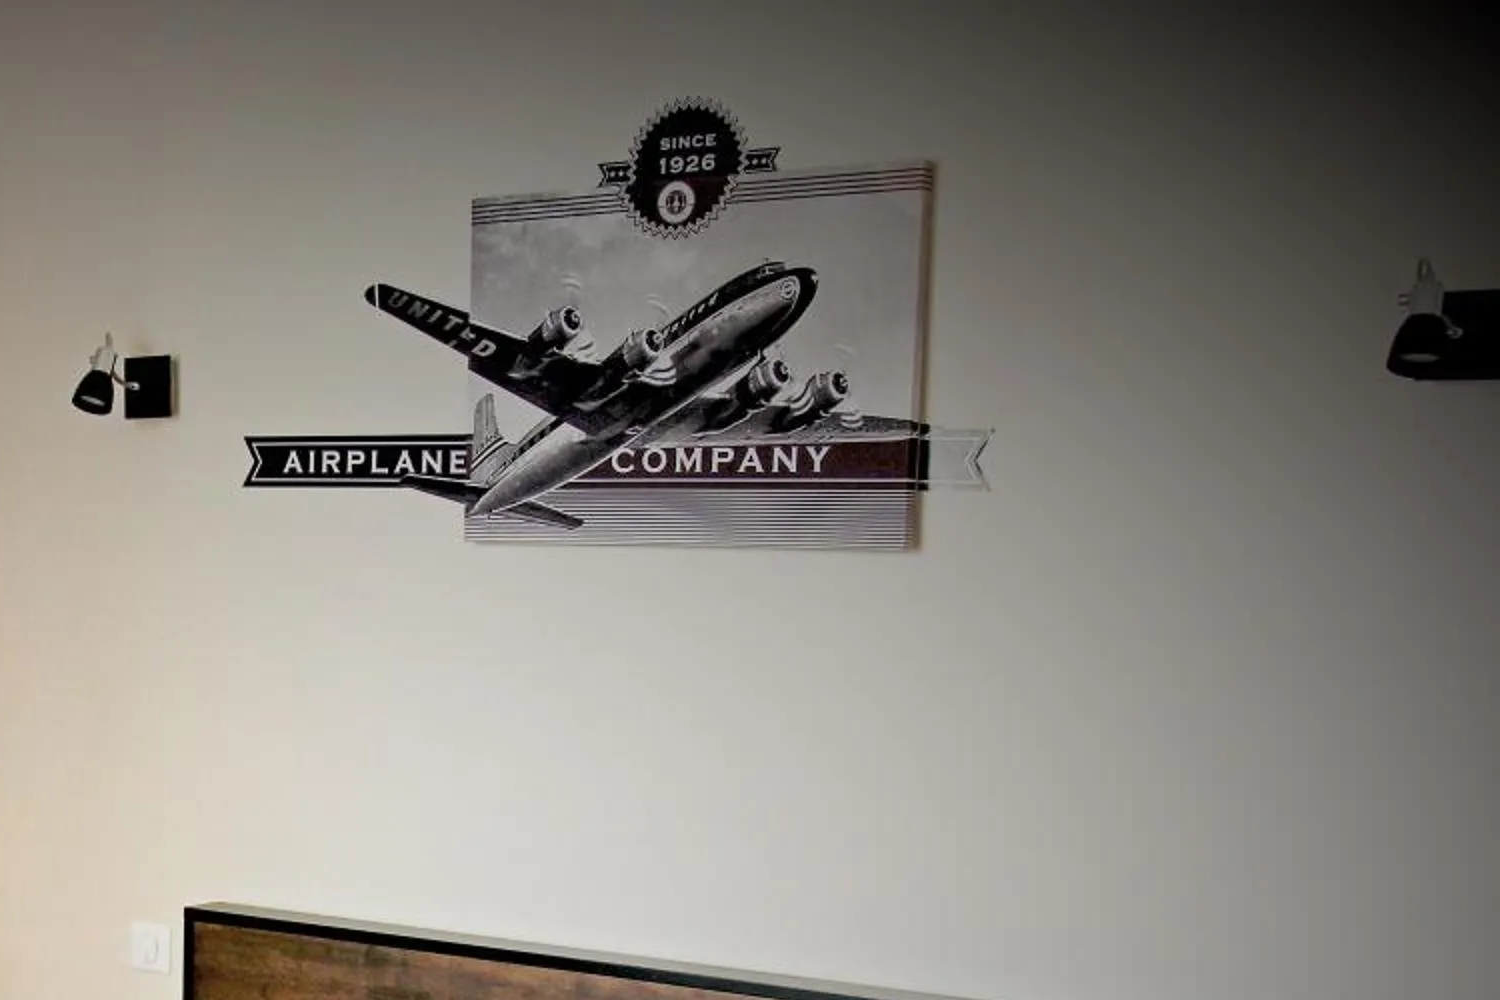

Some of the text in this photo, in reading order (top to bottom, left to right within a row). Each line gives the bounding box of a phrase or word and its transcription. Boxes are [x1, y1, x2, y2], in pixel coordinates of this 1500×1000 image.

[660, 133, 717, 151] SINCE
[660, 153, 716, 175] 1926
[283, 447, 831, 475] AIRPLANE COMPANY
